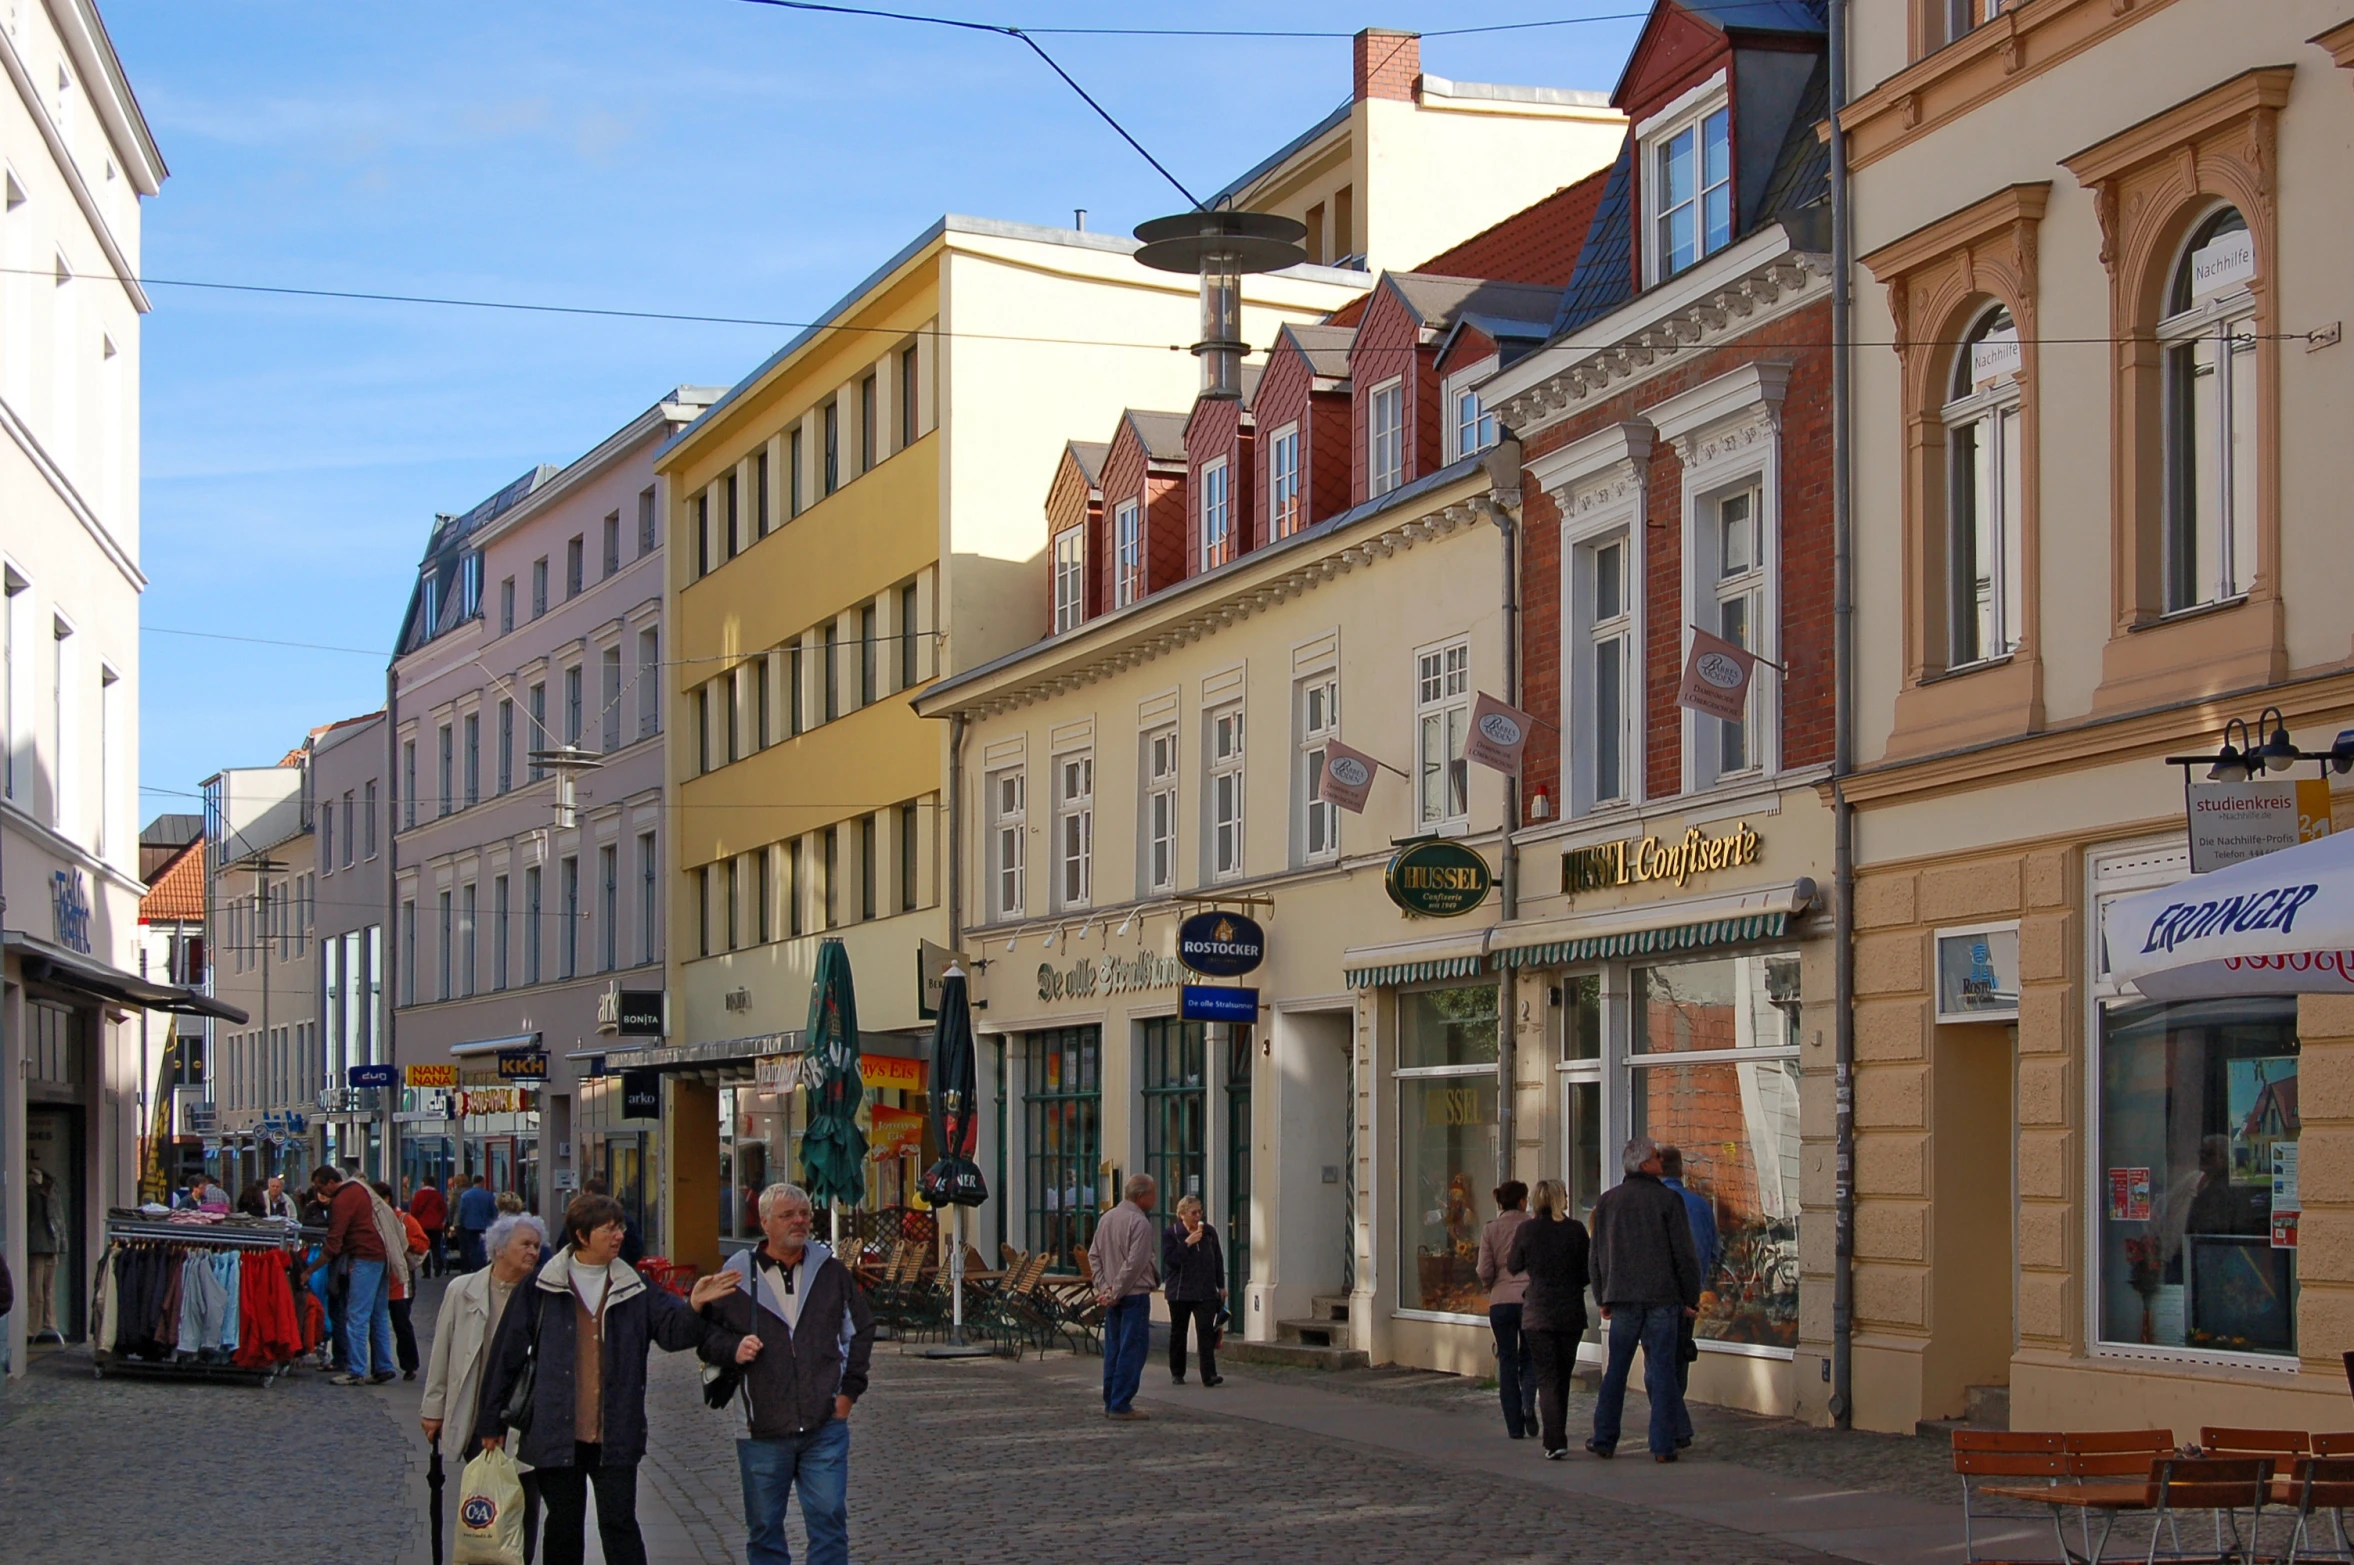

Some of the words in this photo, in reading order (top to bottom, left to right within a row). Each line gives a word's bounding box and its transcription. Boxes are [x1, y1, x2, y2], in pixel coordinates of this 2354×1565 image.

[2196, 249, 2249, 281] Nachhilfe
[1975, 343, 2018, 369] Nachhilfe
[2197, 795, 2292, 812] studienkreis
[2199, 837, 2214, 846] Die
[2217, 833, 2294, 846] Nachhilfe-Profis
[1562, 840, 1629, 894] HUSSEL
[1636, 821, 1760, 888] Confiserie
[2214, 850, 2244, 859] Telefon
[1404, 866, 1481, 890] HUSSEL
[1423, 892, 1463, 904] Confiserie
[2140, 884, 2319, 934] ERDINGER
[1184, 940, 1259, 957] ROSTOCKER
[928, 978, 943, 990] BER
[1037, 962, 1064, 1003] De
[1065, 957, 1097, 999] olle
[597, 979, 617, 1023] ark
[1215, 1001, 1254, 1009] Stralsunner
[1520, 1000, 1530, 1021] 2
[413, 1065, 451, 1076] NANU
[502, 1059, 544, 1074] KKH
[863, 1063, 885, 1079] ny's
[889, 1059, 914, 1080] Eis
[413, 1076, 453, 1085] NANA
[628, 1091, 655, 1105] arko
[887, 1131, 905, 1141] Eis
[466, 1504, 489, 1520] C&A
